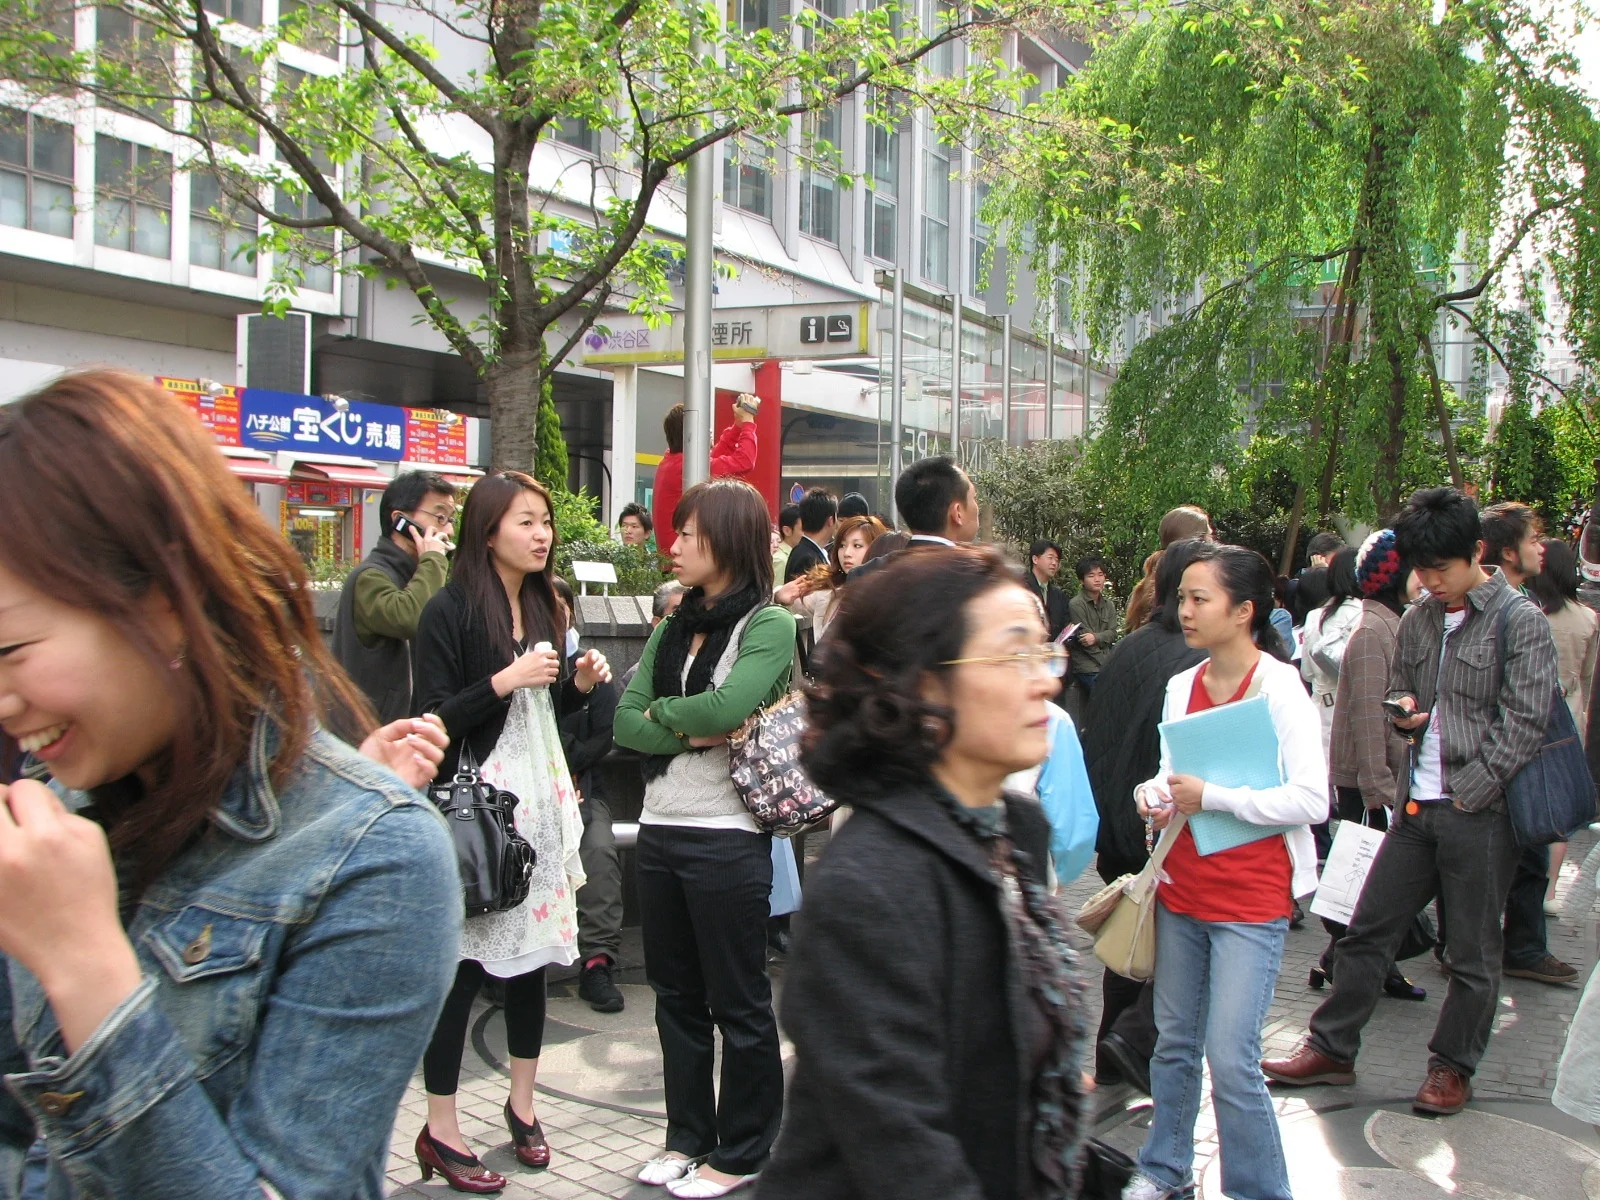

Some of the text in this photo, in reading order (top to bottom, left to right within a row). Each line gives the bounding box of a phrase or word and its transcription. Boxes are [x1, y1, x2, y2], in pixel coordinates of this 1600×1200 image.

[608, 328, 651, 350] 渋谷区
[246, 413, 292, 434] ハチ公前
[293, 406, 363, 446] 宝くじ
[365, 421, 402, 450] 売場
